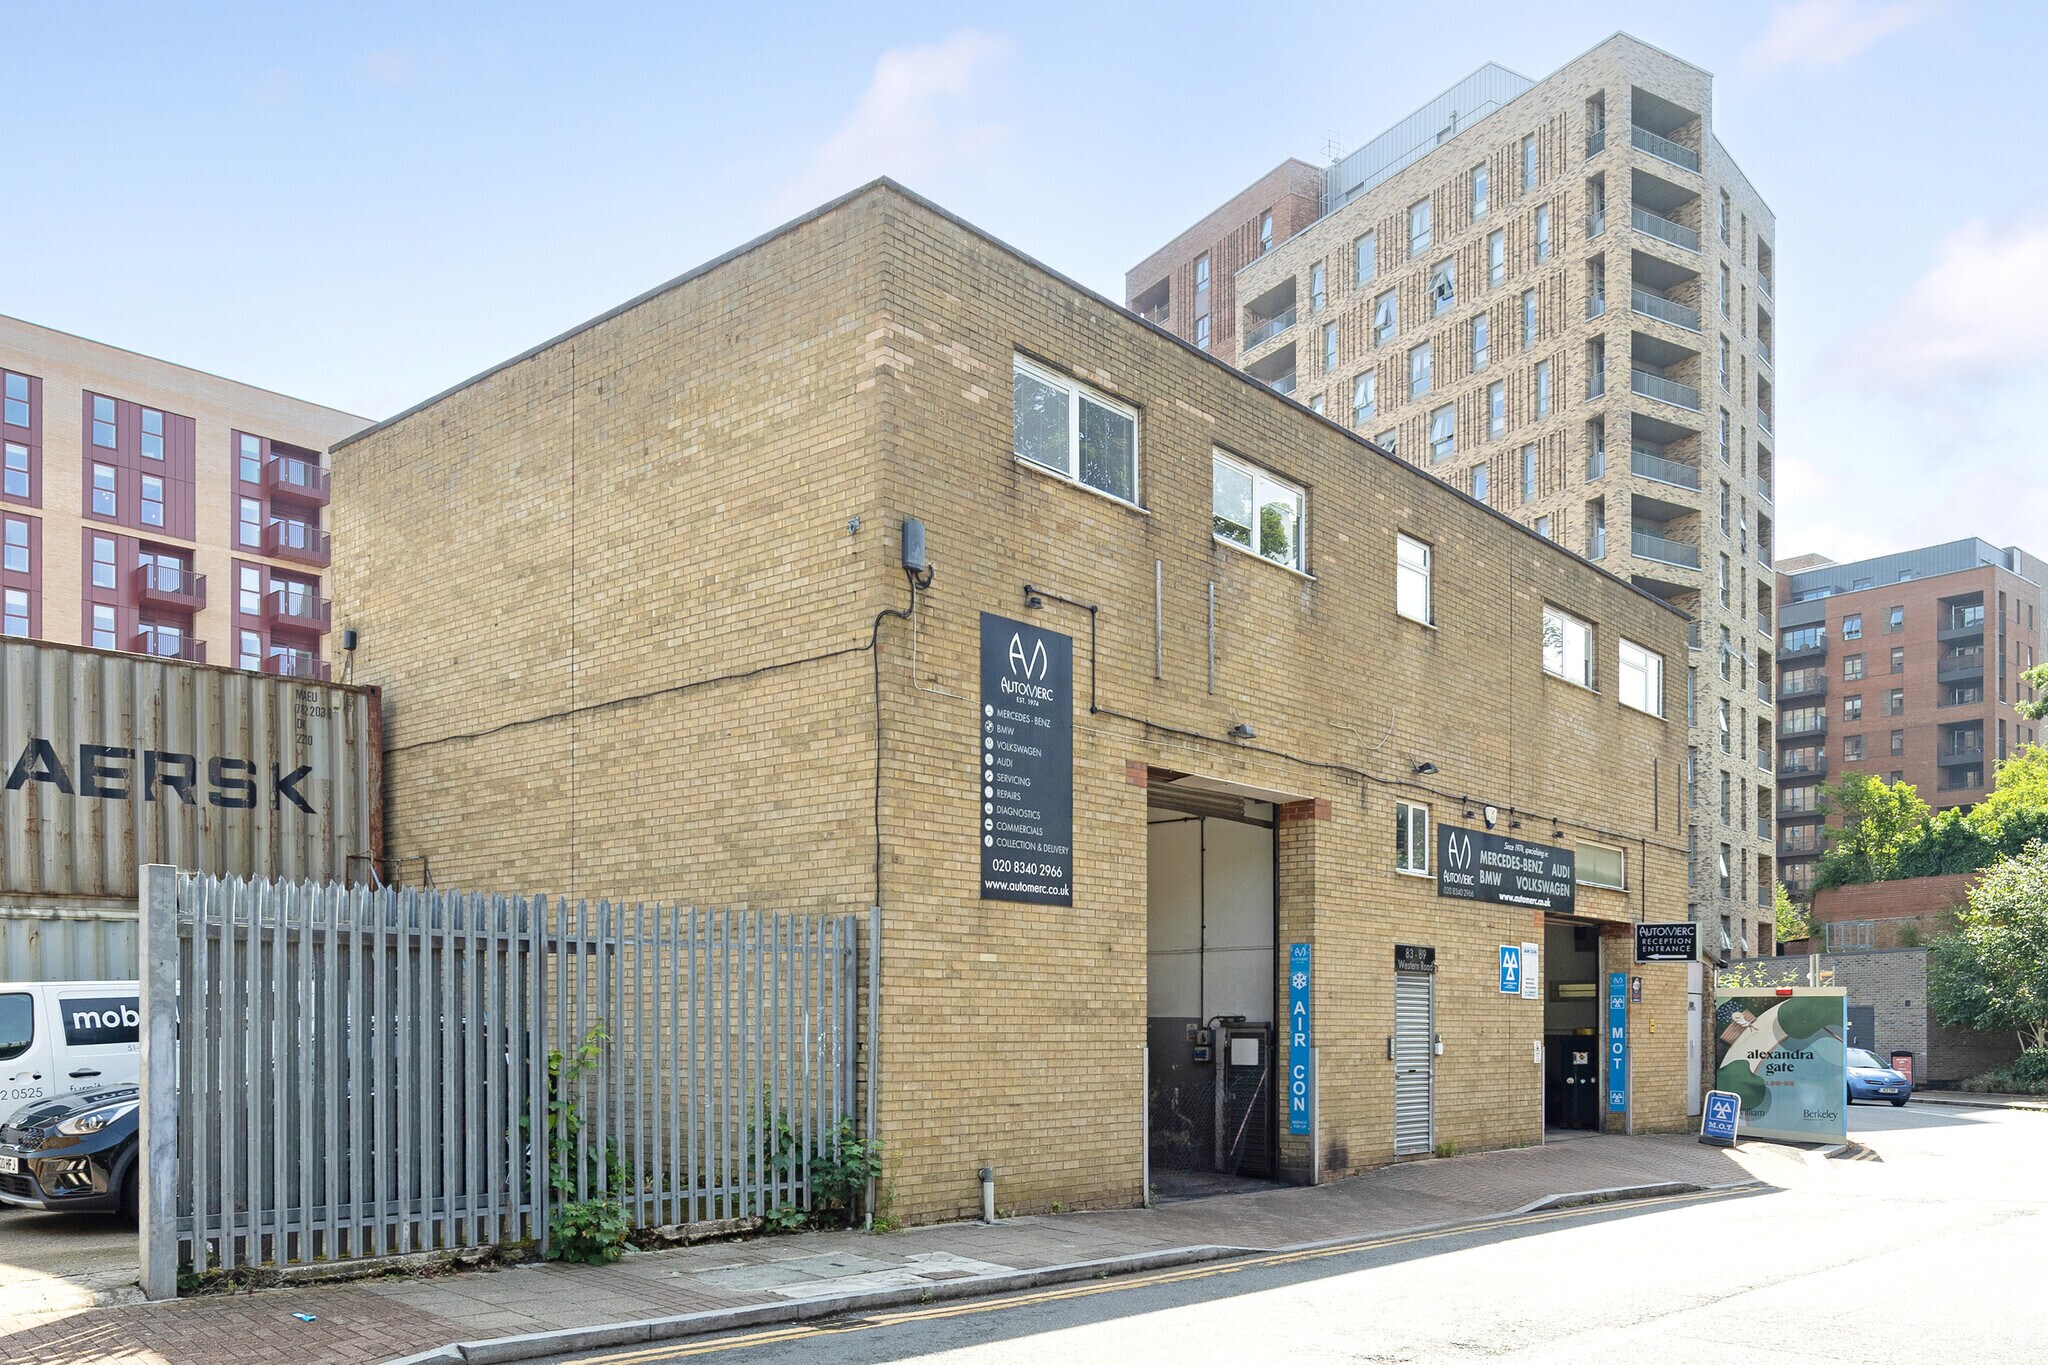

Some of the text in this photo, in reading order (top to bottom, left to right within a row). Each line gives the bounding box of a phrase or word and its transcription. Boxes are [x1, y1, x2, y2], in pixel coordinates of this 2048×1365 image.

[296, 689, 318, 702] MAEU
[1001, 676, 1054, 701] AUTOMERC
[1016, 697, 1039, 707] EST. 1974
[310, 706, 326, 718] 203
[997, 709, 1031, 723] MERCEDES
[1034, 717, 1051, 728] BENZ
[297, 719, 307, 730] DK
[997, 725, 1015, 736] BMW
[997, 741, 1042, 757] VOLKSWAGEN
[997, 757, 1013, 768] AUDI
[997, 773, 1031, 787] SERVICING
[997, 789, 1021, 801] REPAIRS
[997, 805, 1041, 820] DIAGNOSTICS
[997, 822, 1044, 836] COMMERCIALS
[997, 838, 1070, 856] COLLECTION & DELIVERY
[992, 858, 1063, 878] 020 8340 2966
[1480, 850, 1570, 879] MERCEDES-BENZ AUDI
[1443, 869, 1475, 886] AUTOMERC
[1480, 869, 1571, 897] BMW VOLKSWAGEN
[984, 880, 1070, 896] www.automerc.co.uk
[1443, 886, 1453, 895] 020
[1452, 887, 1463, 896] 8340
[1639, 922, 1695, 937] AUTOMERC
[1641, 937, 1692, 946] RECEPTION
[1405, 947, 1414, 959] 83
[1418, 949, 1427, 960] 89
[1642, 945, 1691, 953] ENTRANCE
[1397, 959, 1434, 971] Western Road
[72, 1004, 140, 1030] mob
[1293, 1000, 1307, 1047] AIR
[128, 1044, 140, 1052] 51-
[1612, 1027, 1623, 1070] MOT
[1747, 1049, 1814, 1060] alexandra
[1765, 1063, 1795, 1077] gate
[11, 1087, 43, 1100] 0525
[1293, 1065, 1307, 1112] CON
[1803, 1109, 1839, 1122] Berkeley
[1708, 1121, 1734, 1131] M.O.T.
